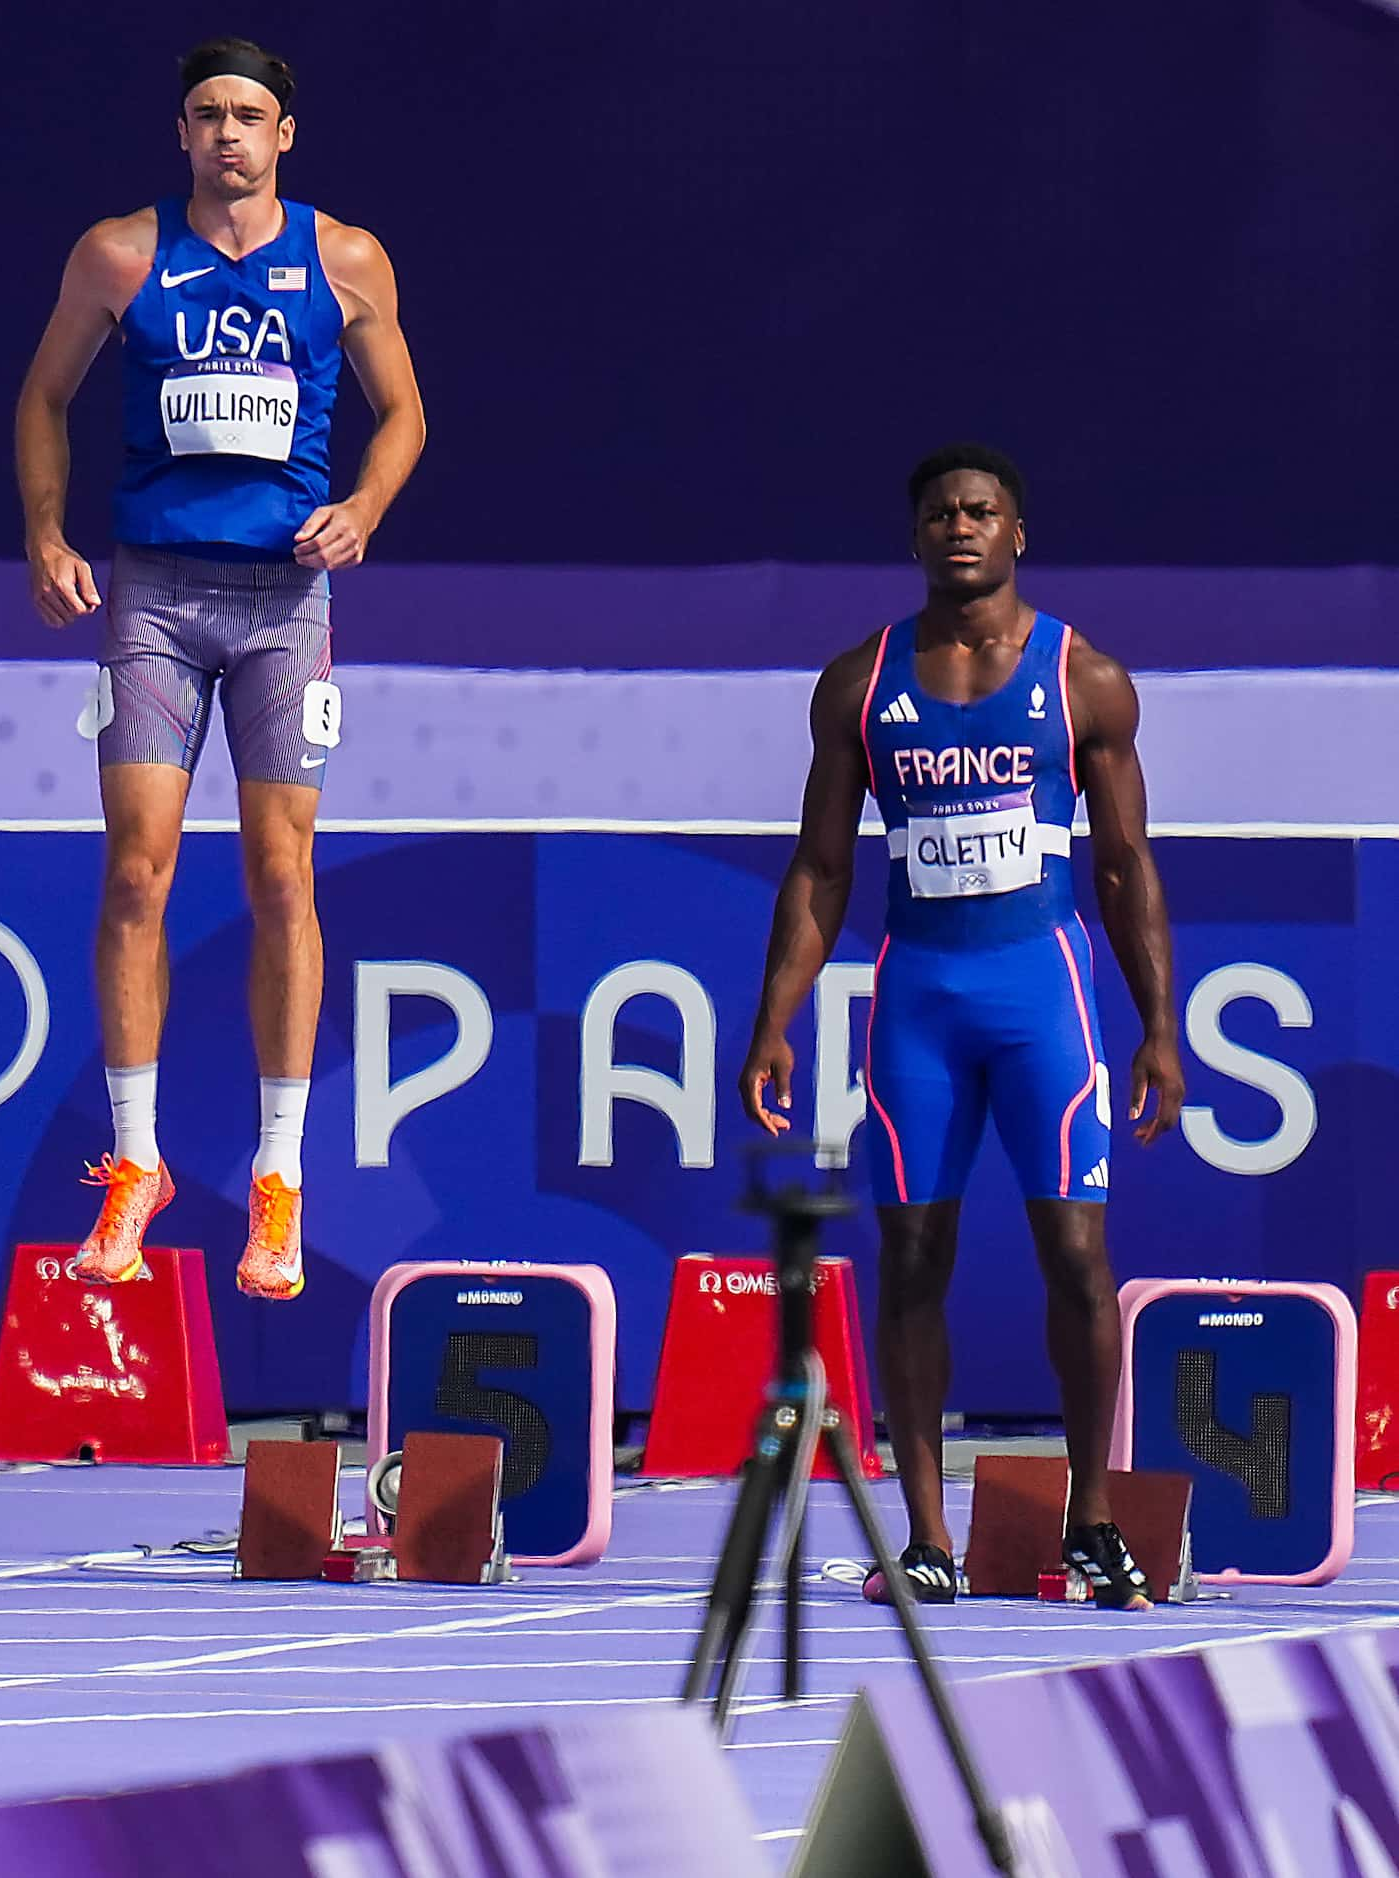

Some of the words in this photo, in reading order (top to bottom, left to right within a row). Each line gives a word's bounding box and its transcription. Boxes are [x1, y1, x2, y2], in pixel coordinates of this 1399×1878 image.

[176, 306, 291, 362] USA
[166, 392, 292, 427] WILLIAMS
[894, 746, 1035, 786] FRANCE
[467, 1290, 523, 1305] MONDO
[1210, 1312, 1264, 1328] MONDO
[435, 1332, 549, 1501] 5
[1175, 1347, 1292, 1520] 4
